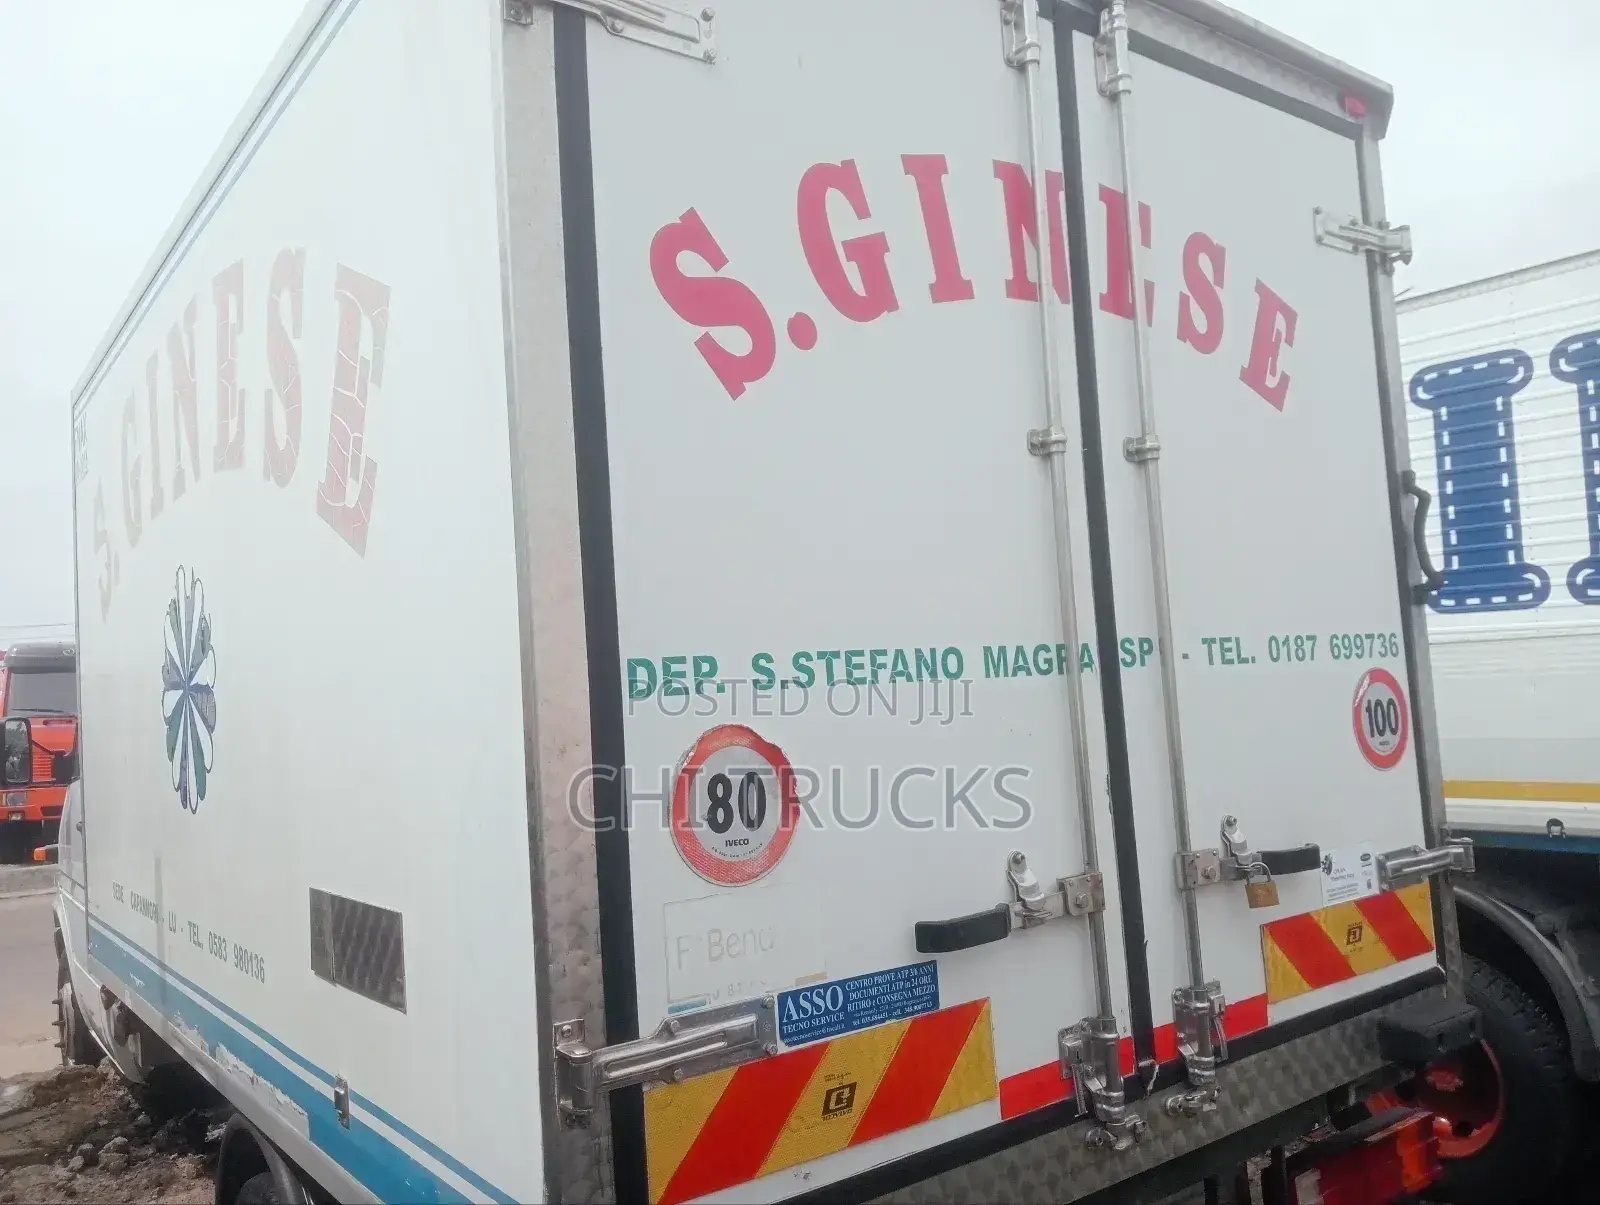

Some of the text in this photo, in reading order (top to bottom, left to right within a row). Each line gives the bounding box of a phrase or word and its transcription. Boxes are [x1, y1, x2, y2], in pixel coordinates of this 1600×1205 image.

[627, 656, 726, 700] DEP.
[751, 646, 964, 690] S.STEFANO
[1201, 636, 1256, 665] TEL.
[1268, 634, 1317, 662] 0187
[1329, 632, 1399, 660] 699736
[1366, 698, 1399, 738] 100
[707, 771, 767, 834] 80
[725, 838, 750, 847] IVECO
[208, 931, 228, 963] 0583
[233, 943, 265, 984] 980136
[845, 977, 873, 991] CENTRO
[874, 972, 896, 985] PROVE
[918, 964, 934, 976] ANNI
[849, 983, 890, 1001] DOCUMENTI
[891, 980, 904, 991] ATP
[918, 974, 933, 985] ORE
[782, 985, 844, 1023] ASSO
[847, 998, 872, 1013] RITIRO
[876, 990, 912, 1005] CONSEGNA
[912, 984, 936, 998] MEZZO
[782, 1011, 845, 1034] TECNO SERVICE
